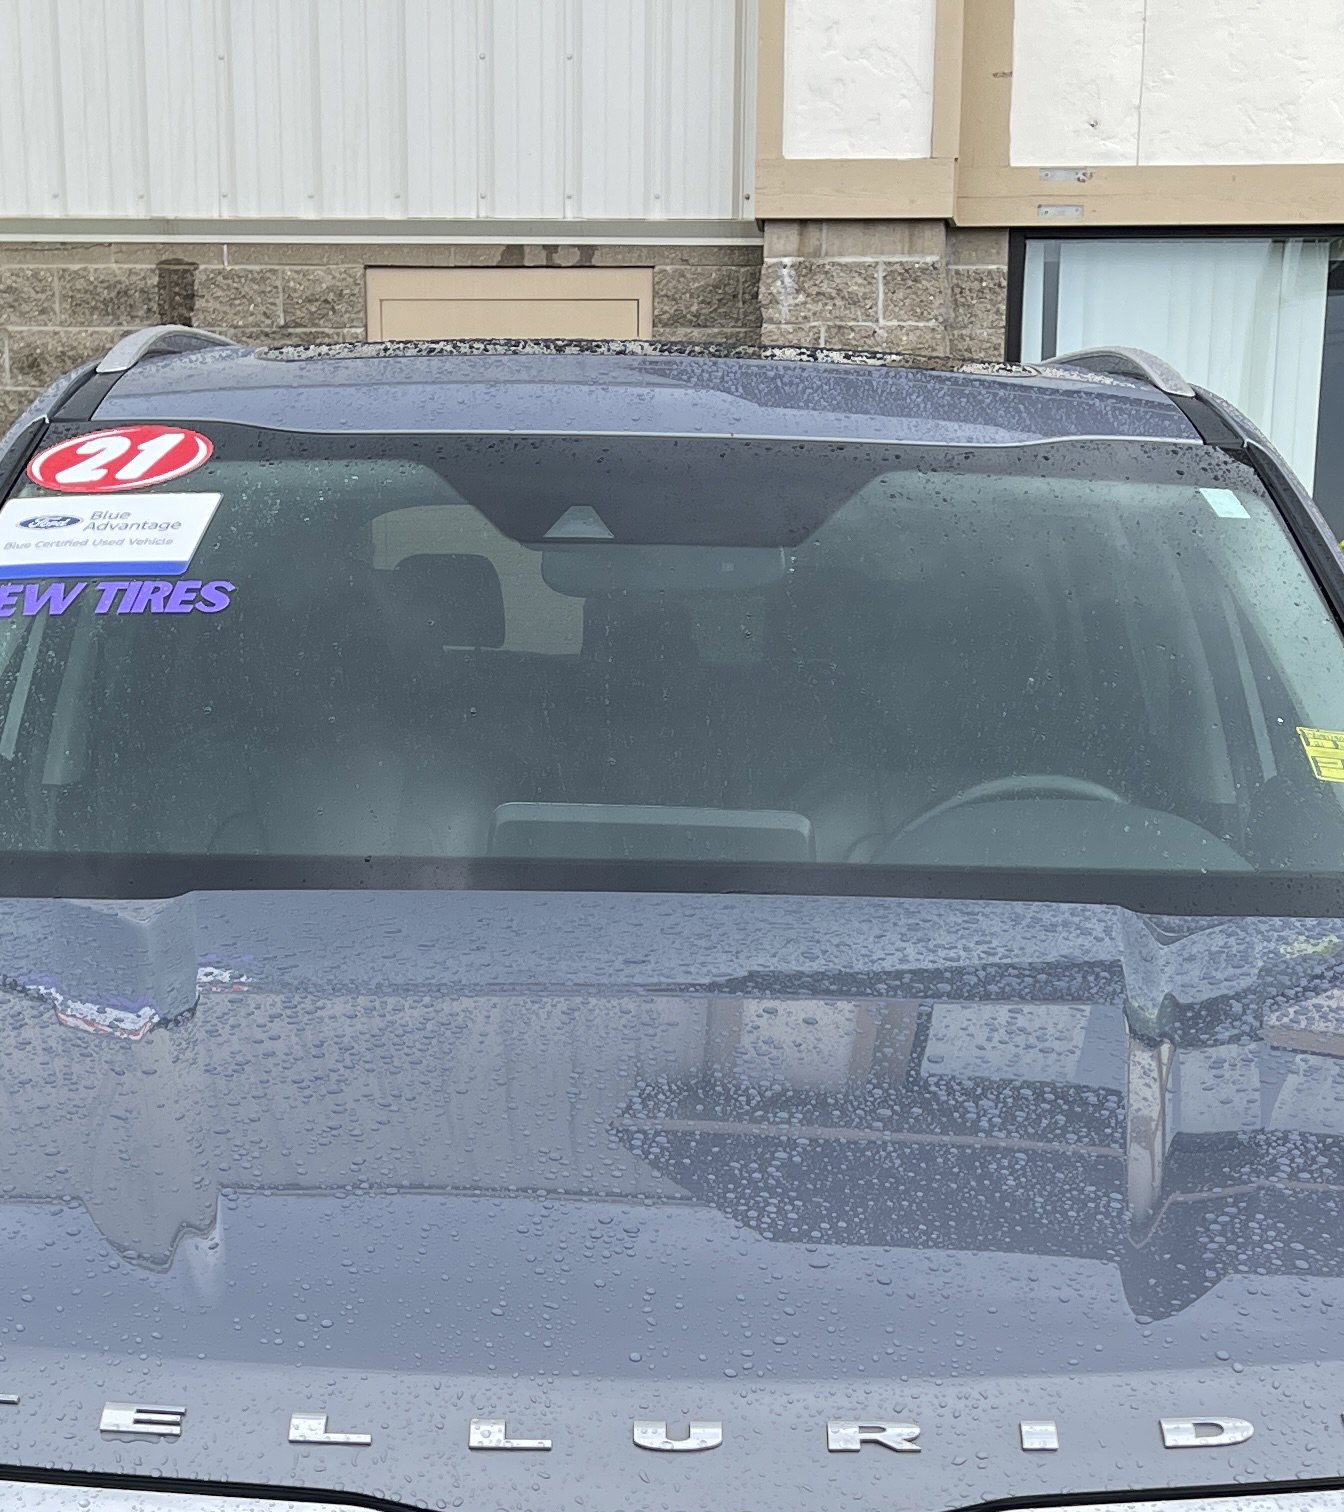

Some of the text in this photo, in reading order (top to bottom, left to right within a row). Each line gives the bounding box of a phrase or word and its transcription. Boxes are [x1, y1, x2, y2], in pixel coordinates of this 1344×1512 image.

[55, 433, 185, 484] 21
[90, 510, 132, 521] Blue
[82, 520, 183, 532] Advantage
[3, 537, 174, 550] Blue Certified Used Vehicle
[94, 579, 236, 616] TIRES
